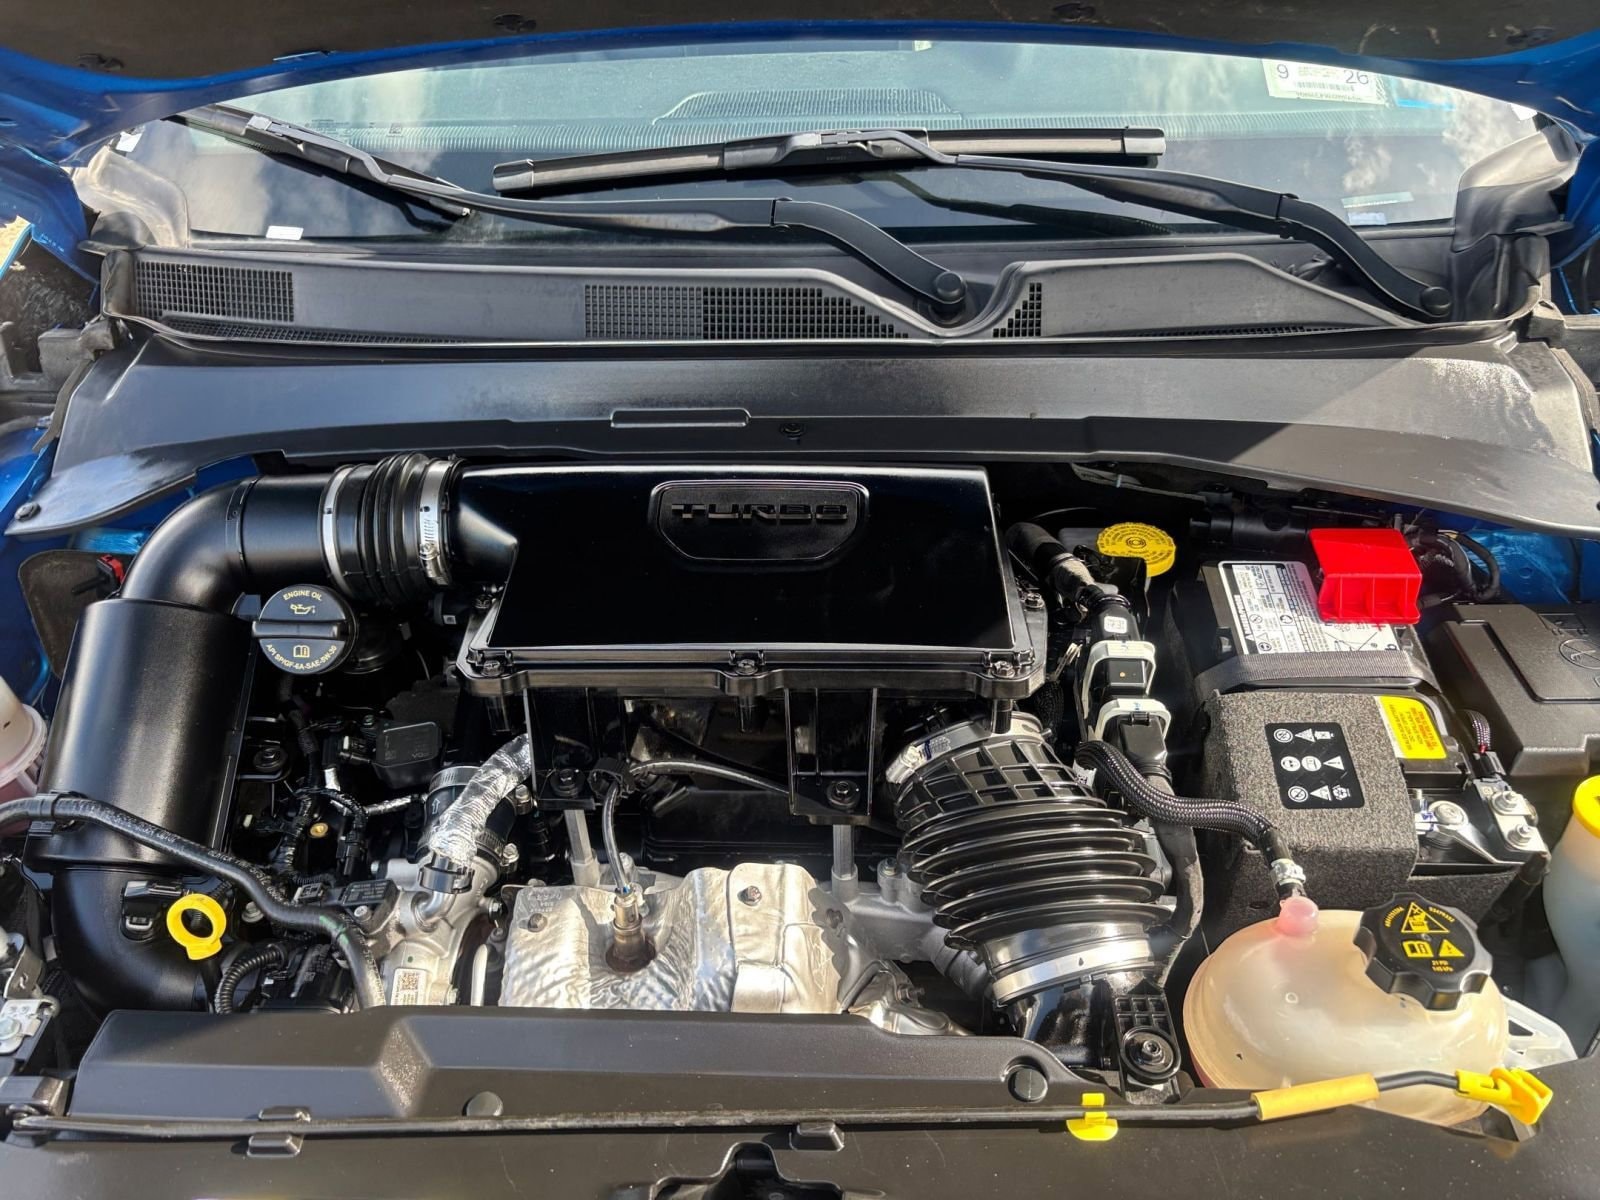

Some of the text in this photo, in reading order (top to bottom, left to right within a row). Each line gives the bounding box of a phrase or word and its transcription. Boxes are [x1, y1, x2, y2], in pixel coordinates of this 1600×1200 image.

[1276, 63, 1289, 79] 9
[1343, 69, 1369, 85] 26
[671, 503, 848, 520] TURBO
[283, 590, 322, 601] ENGINE OIL
[266, 644, 275, 656] API
